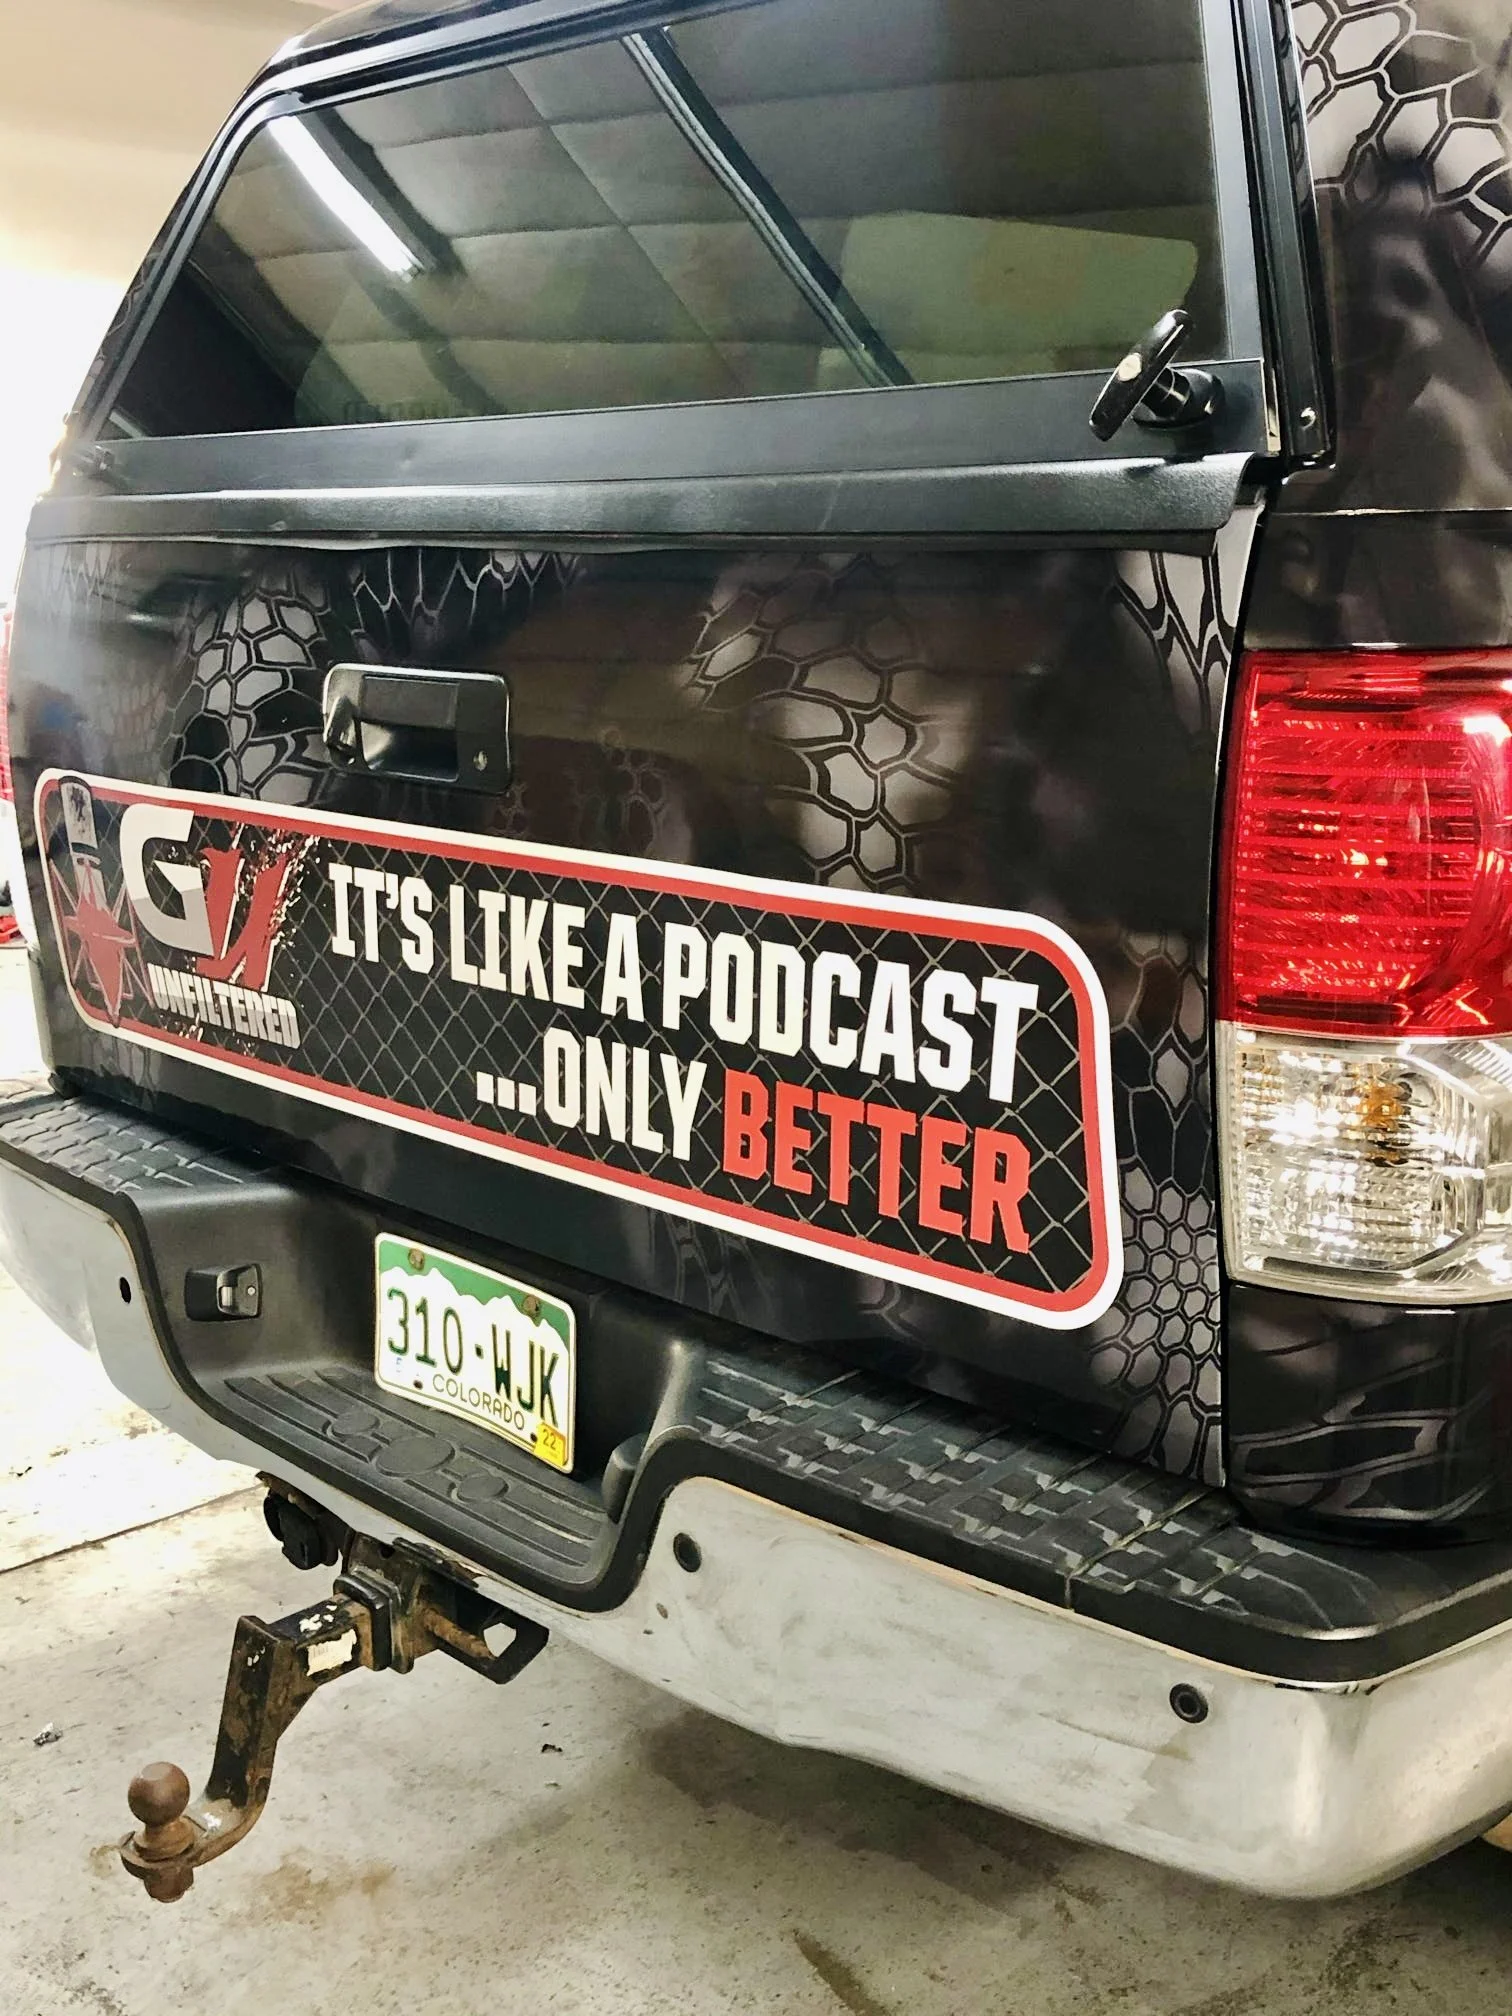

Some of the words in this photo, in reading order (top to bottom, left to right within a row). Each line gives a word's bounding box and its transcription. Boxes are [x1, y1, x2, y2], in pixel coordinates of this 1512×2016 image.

[147, 961, 301, 1049] UNFILTERED
[327, 862, 435, 975] IT'S
[449, 884, 586, 1010] LIKE
[601, 913, 645, 1023] A
[662, 922, 1038, 1104] PODCAST
[722, 1070, 1031, 1255] BETTER
[432, 1373, 525, 1431] COLORADO
[542, 1428, 557, 1451] 22
